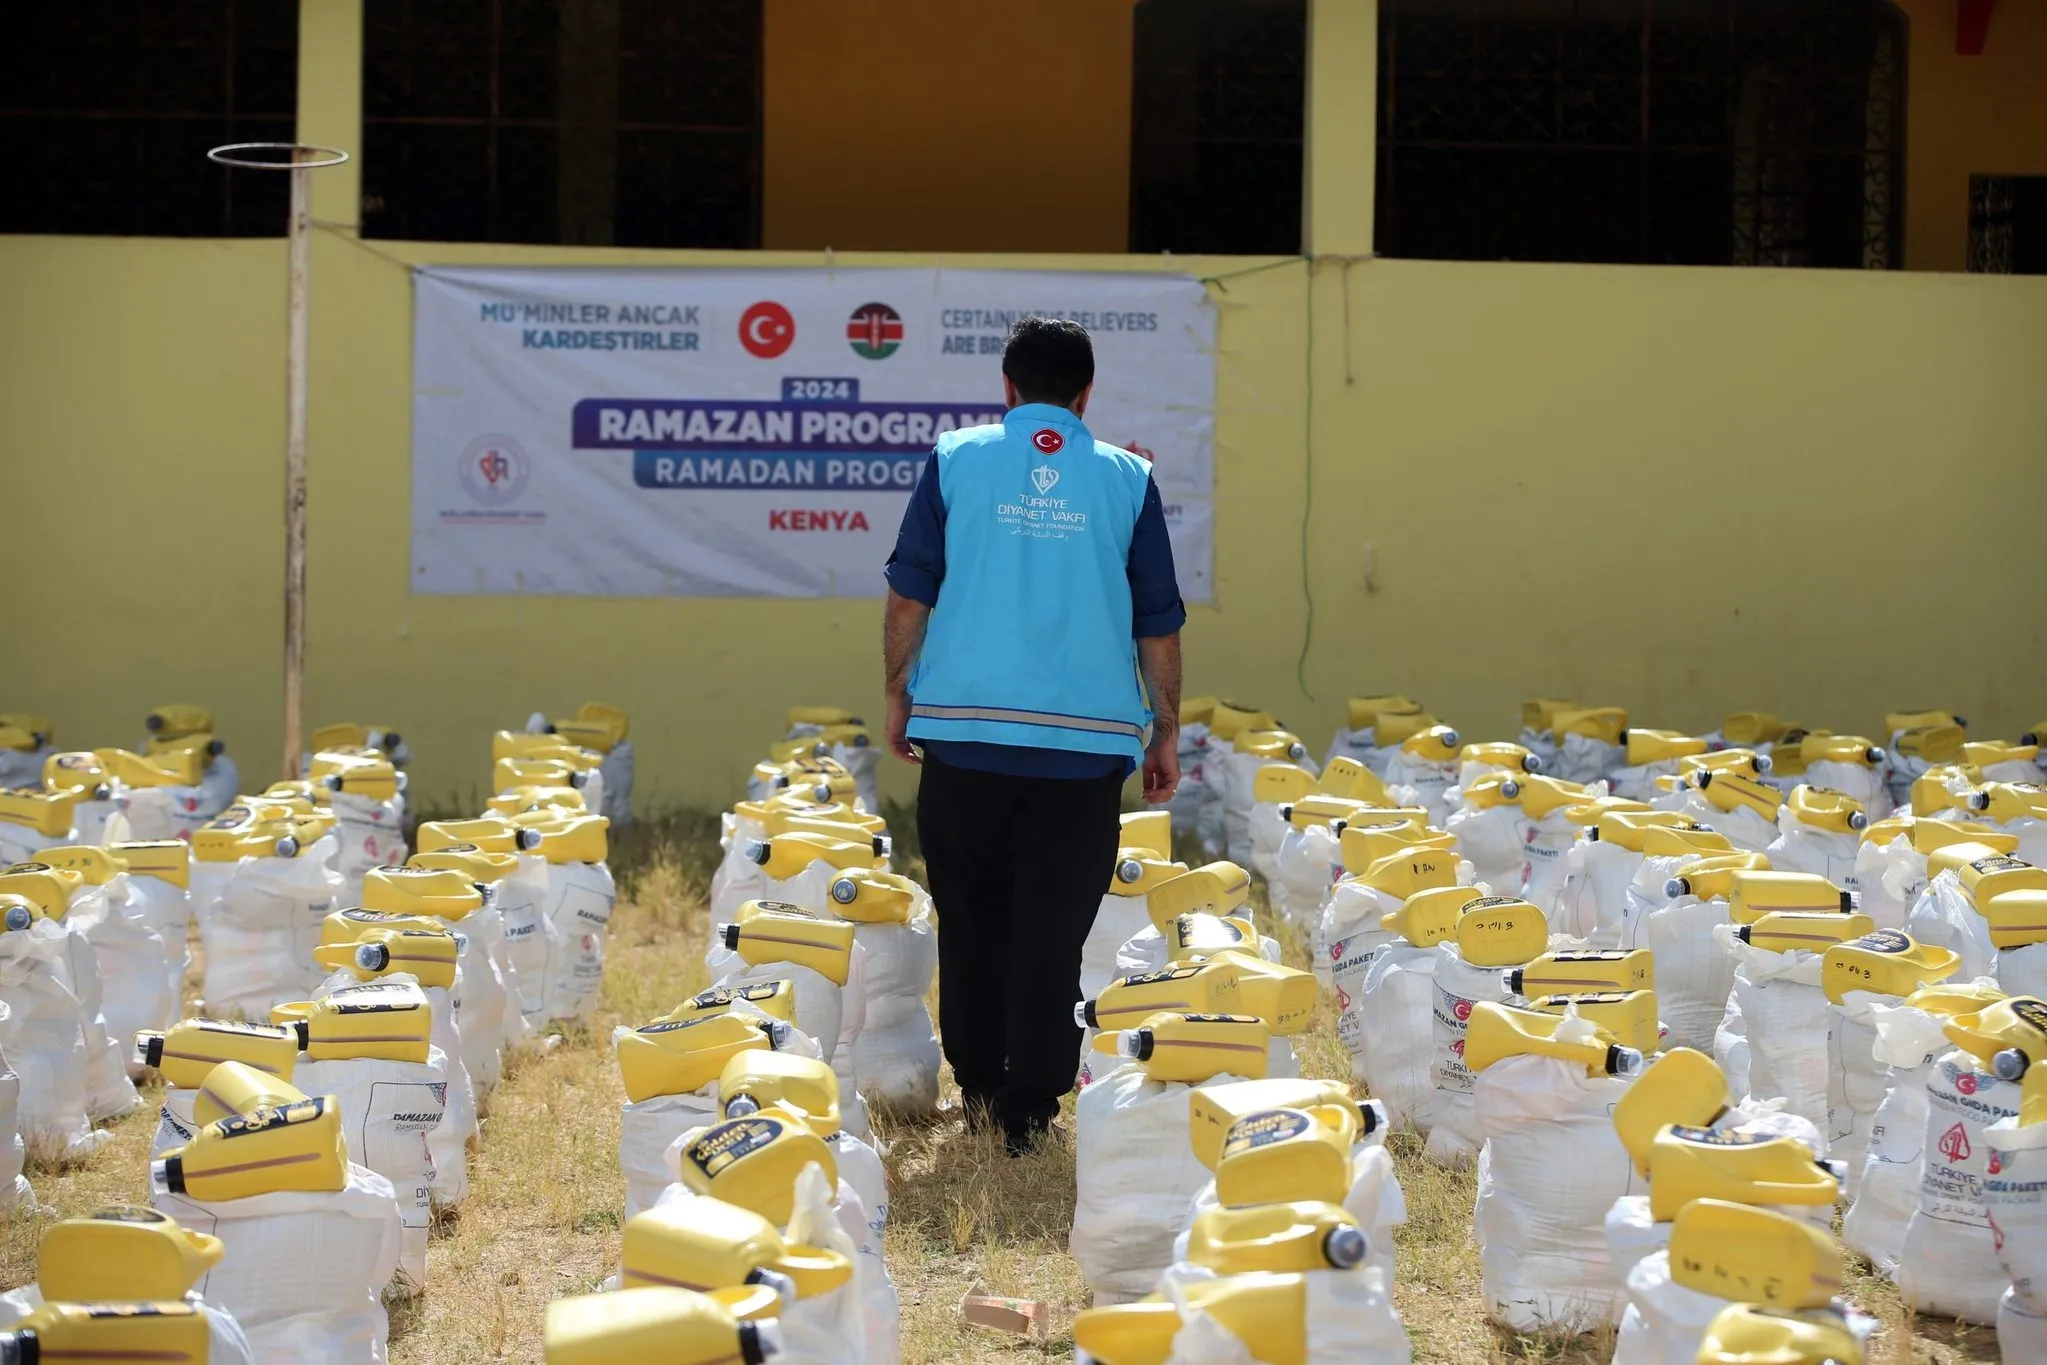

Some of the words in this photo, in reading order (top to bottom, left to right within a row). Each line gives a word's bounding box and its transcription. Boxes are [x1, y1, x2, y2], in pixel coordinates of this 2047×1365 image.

[617, 304, 700, 326] ANCAK
[941, 335, 975, 355] ARE
[791, 380, 849, 400] 2024
[600, 408, 794, 443] RAMAZAN
[656, 457, 815, 484] RAMADAN
[1019, 493, 1068, 509] TÜRKİYE
[769, 508, 869, 533] KENYA
[998, 503, 1047, 520] DİYANET
[1052, 510, 1086, 524] VAKFI
[1960, 1097, 1990, 1114] GIDA
